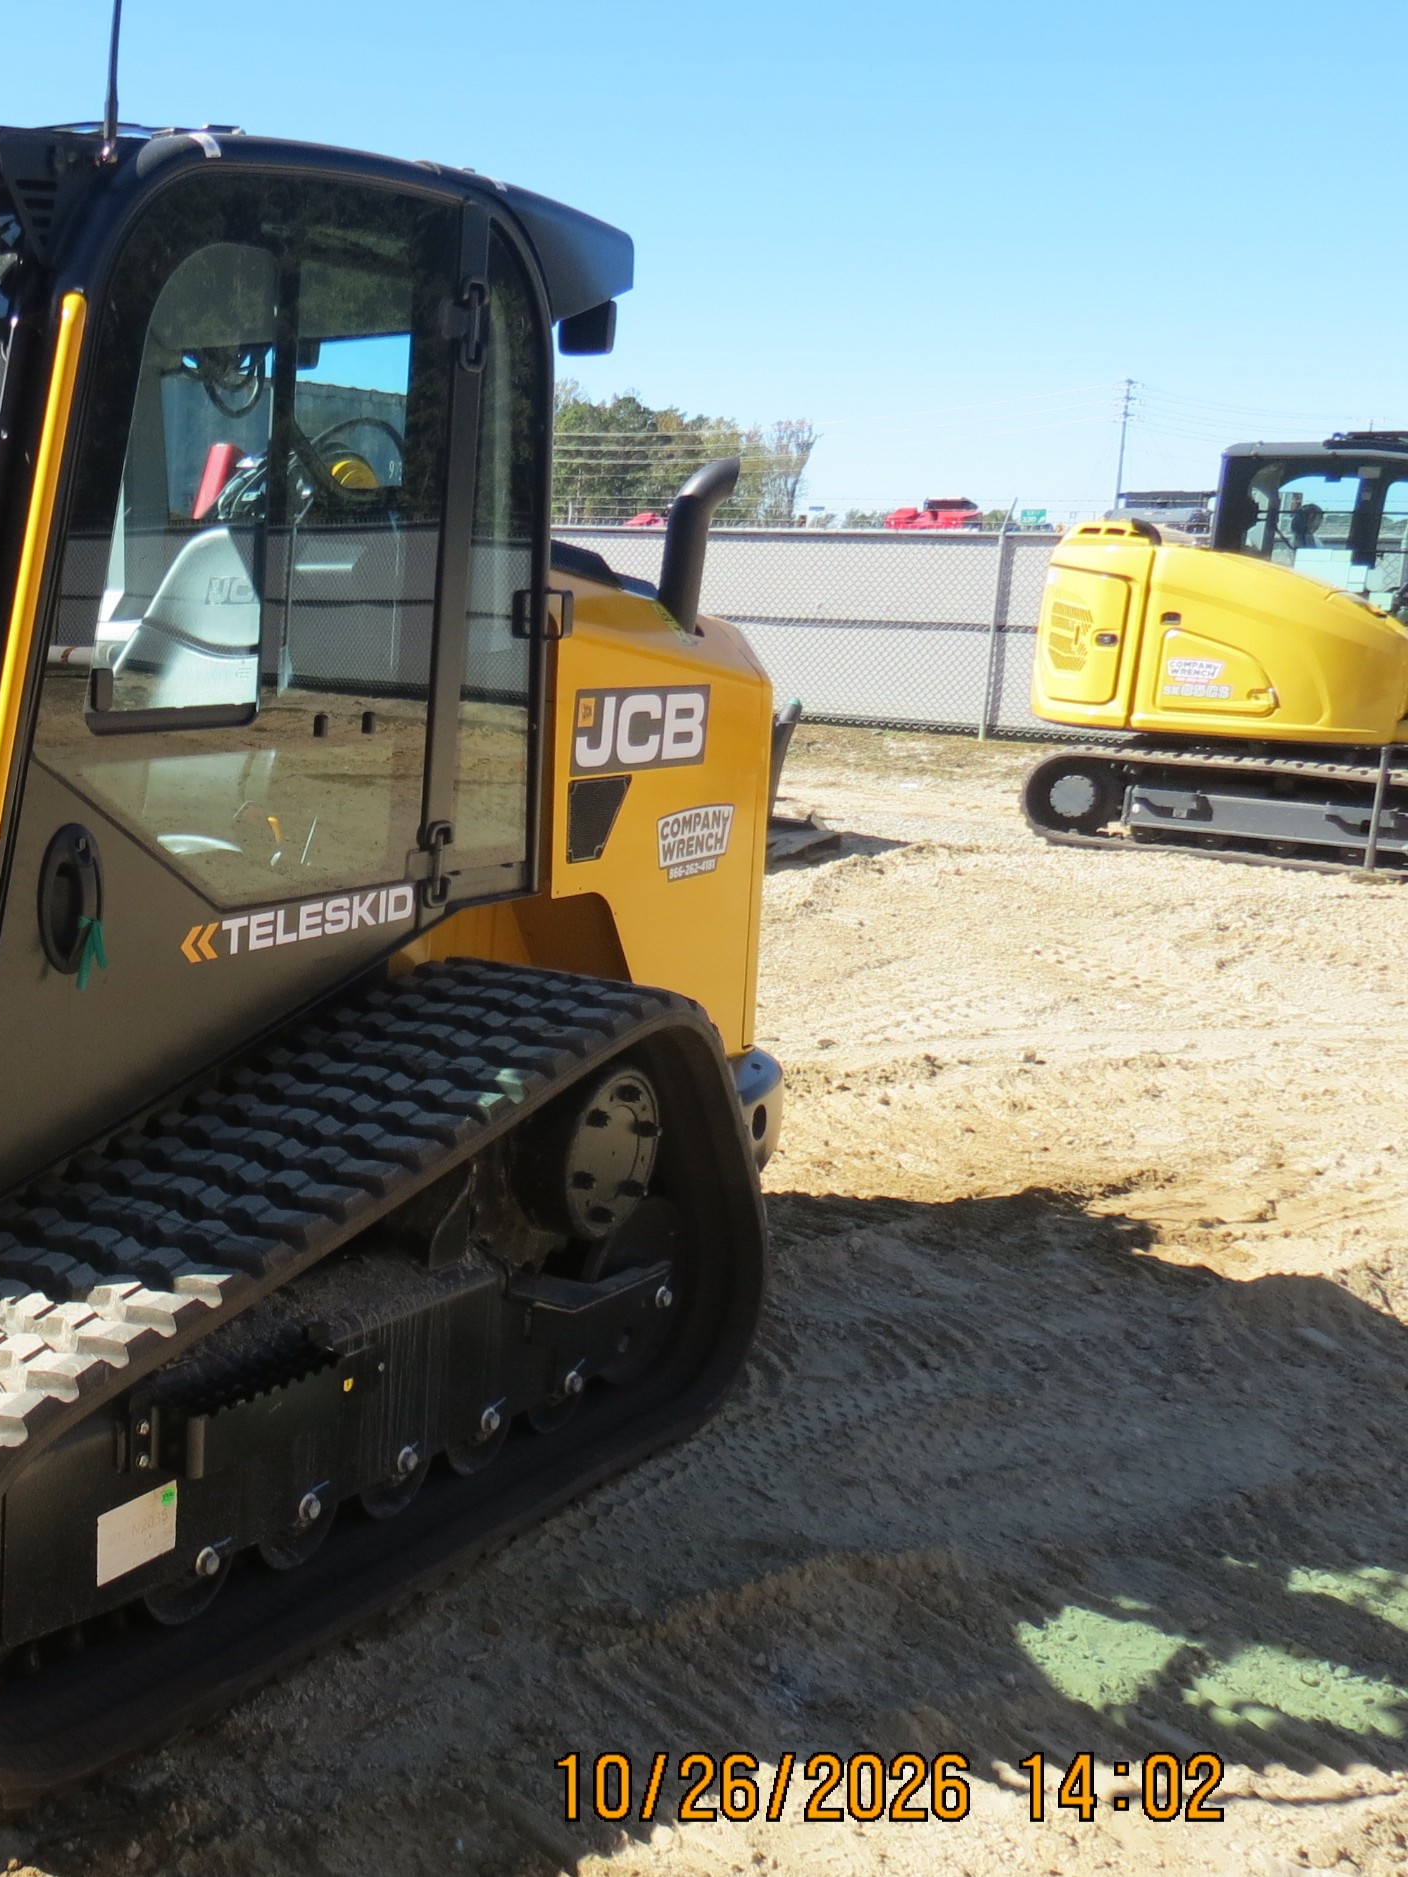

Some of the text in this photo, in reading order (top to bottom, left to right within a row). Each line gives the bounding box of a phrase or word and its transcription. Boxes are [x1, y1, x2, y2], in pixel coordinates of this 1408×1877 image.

[207, 578, 257, 604] JC
[1169, 661, 1219, 670] COMPANY
[1171, 668, 1215, 677] WRENCH
[575, 692, 705, 768] JCB
[660, 809, 730, 842] COMPANY
[661, 831, 724, 863] WRENCH
[221, 886, 414, 956] TELESKID
